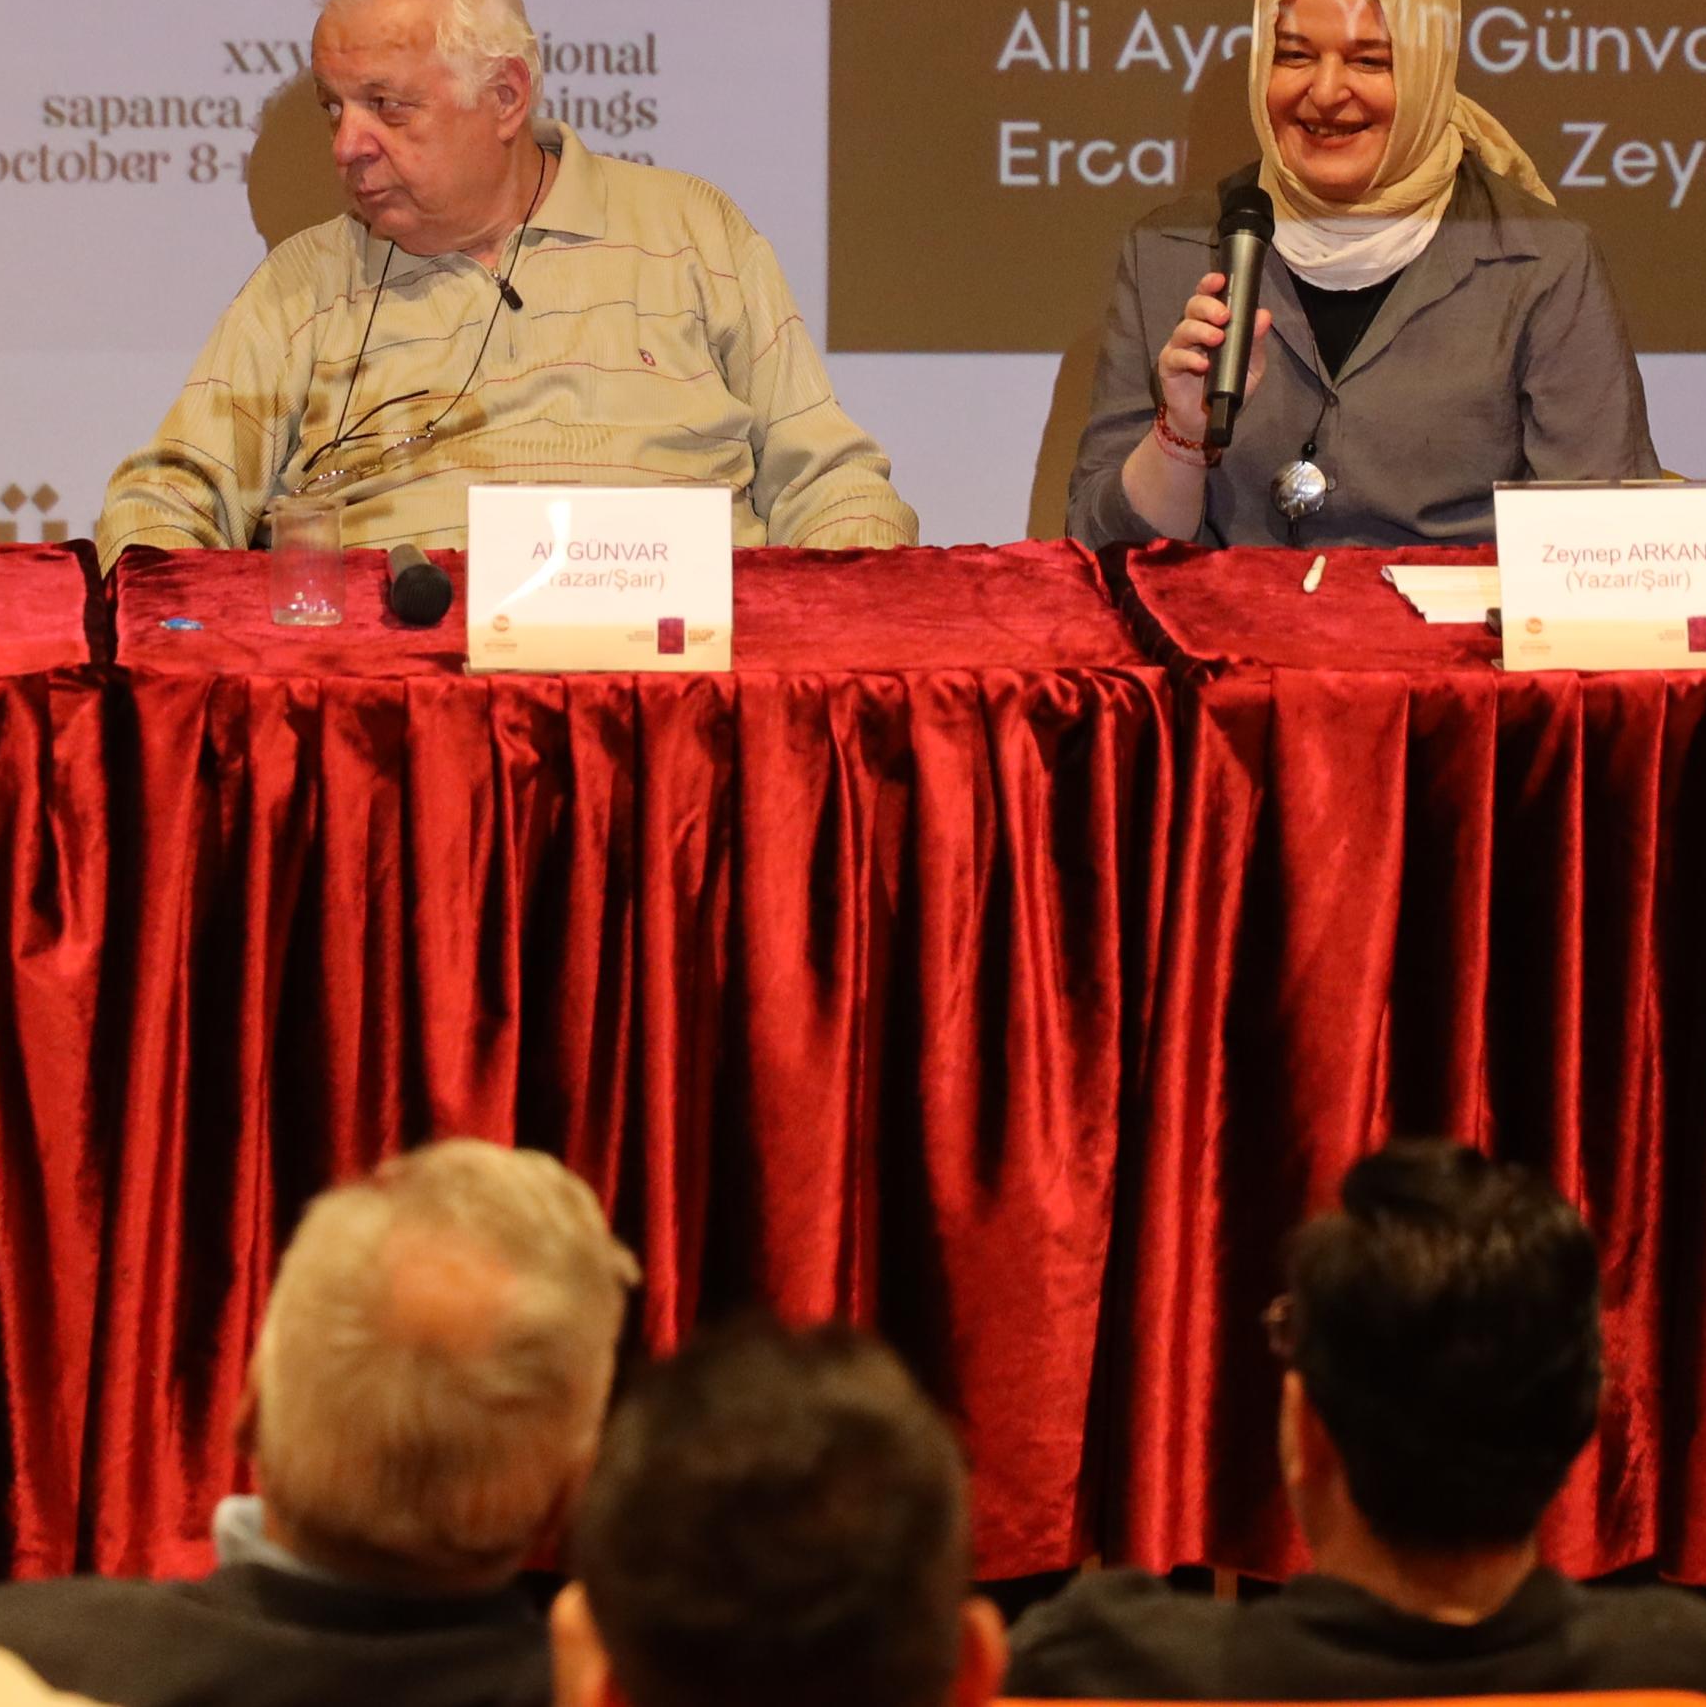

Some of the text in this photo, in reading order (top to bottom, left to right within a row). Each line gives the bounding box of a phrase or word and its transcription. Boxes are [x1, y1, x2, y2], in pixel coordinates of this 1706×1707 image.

[996, 0, 1090, 71] Ali
[42, 96, 244, 137] sapanca
[999, 121, 1188, 186] Erca
[566, 537, 669, 562] GÜNVAR
[1542, 544, 1622, 567] Zeynep
[1565, 568, 1693, 593] (Yazar/Şair)
